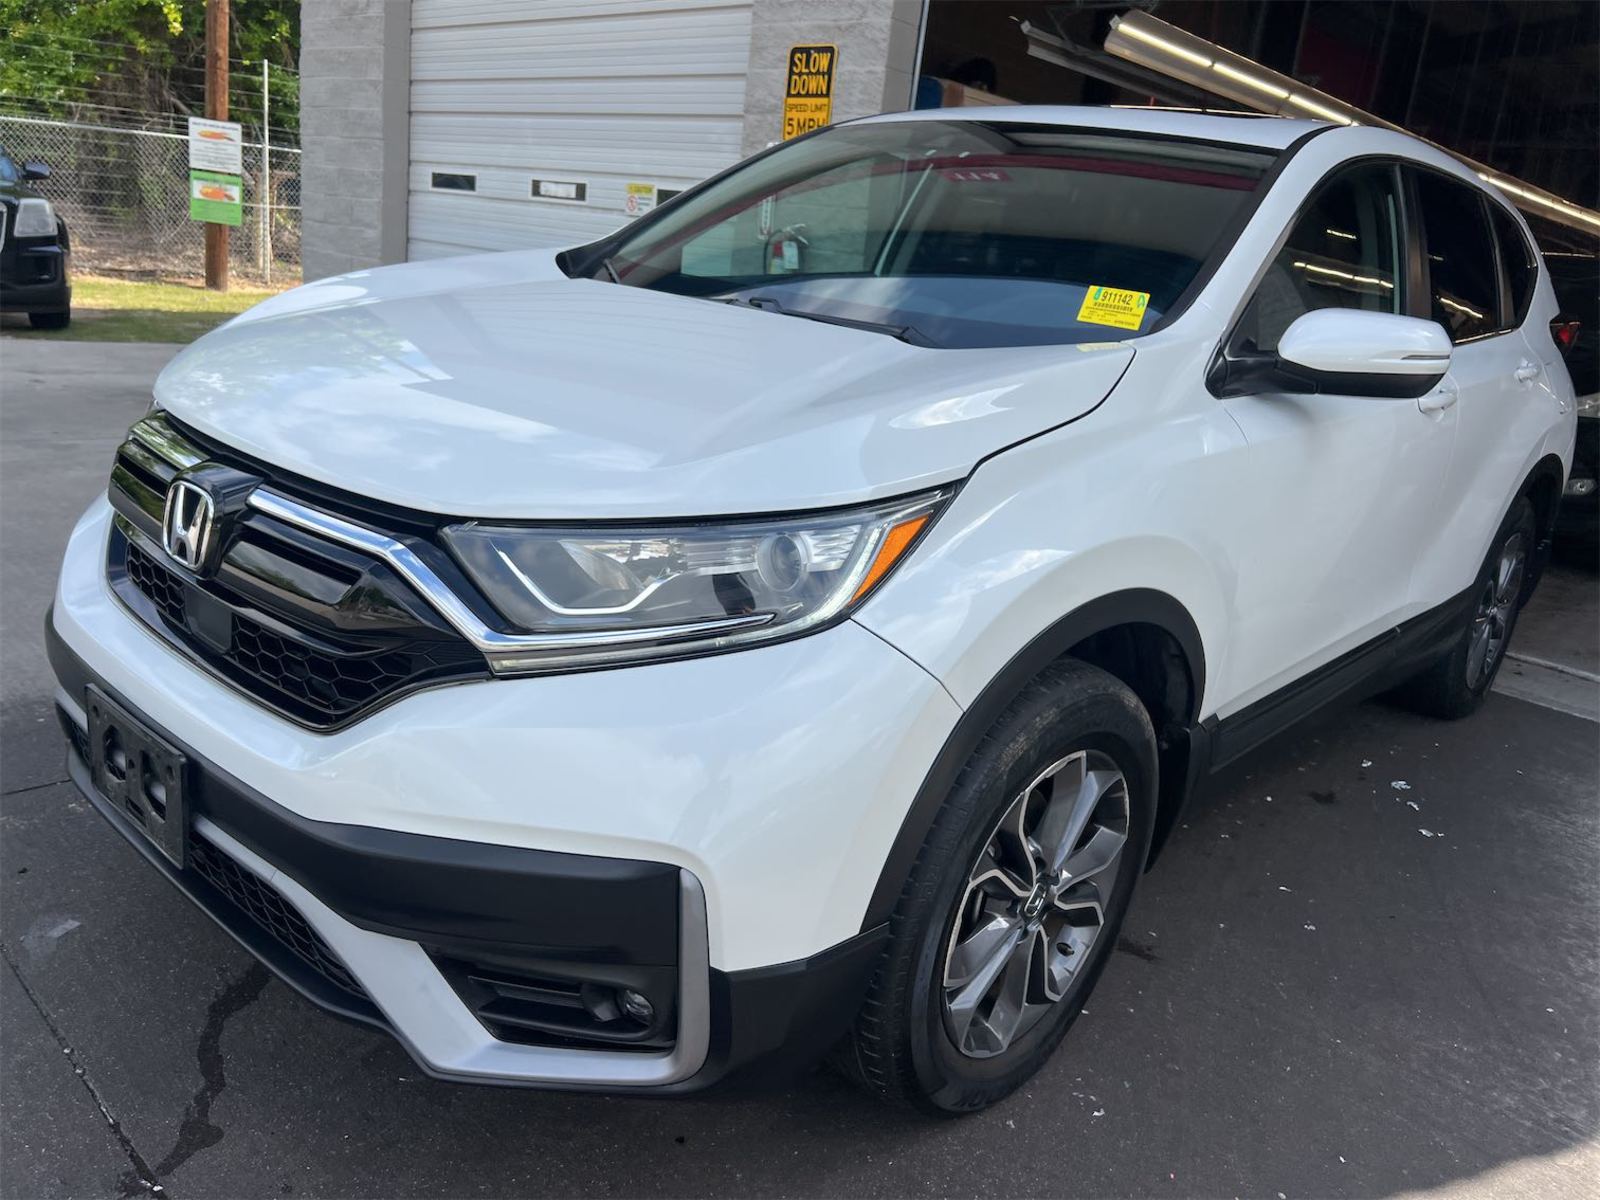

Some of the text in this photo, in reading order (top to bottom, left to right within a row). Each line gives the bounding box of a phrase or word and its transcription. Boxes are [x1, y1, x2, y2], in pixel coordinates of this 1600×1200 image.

[793, 53, 831, 73] SLOW
[790, 75, 828, 94] DOWN
[785, 104, 809, 112] SPEED
[786, 118, 795, 135] 5
[1101, 291, 1133, 306] 911142
